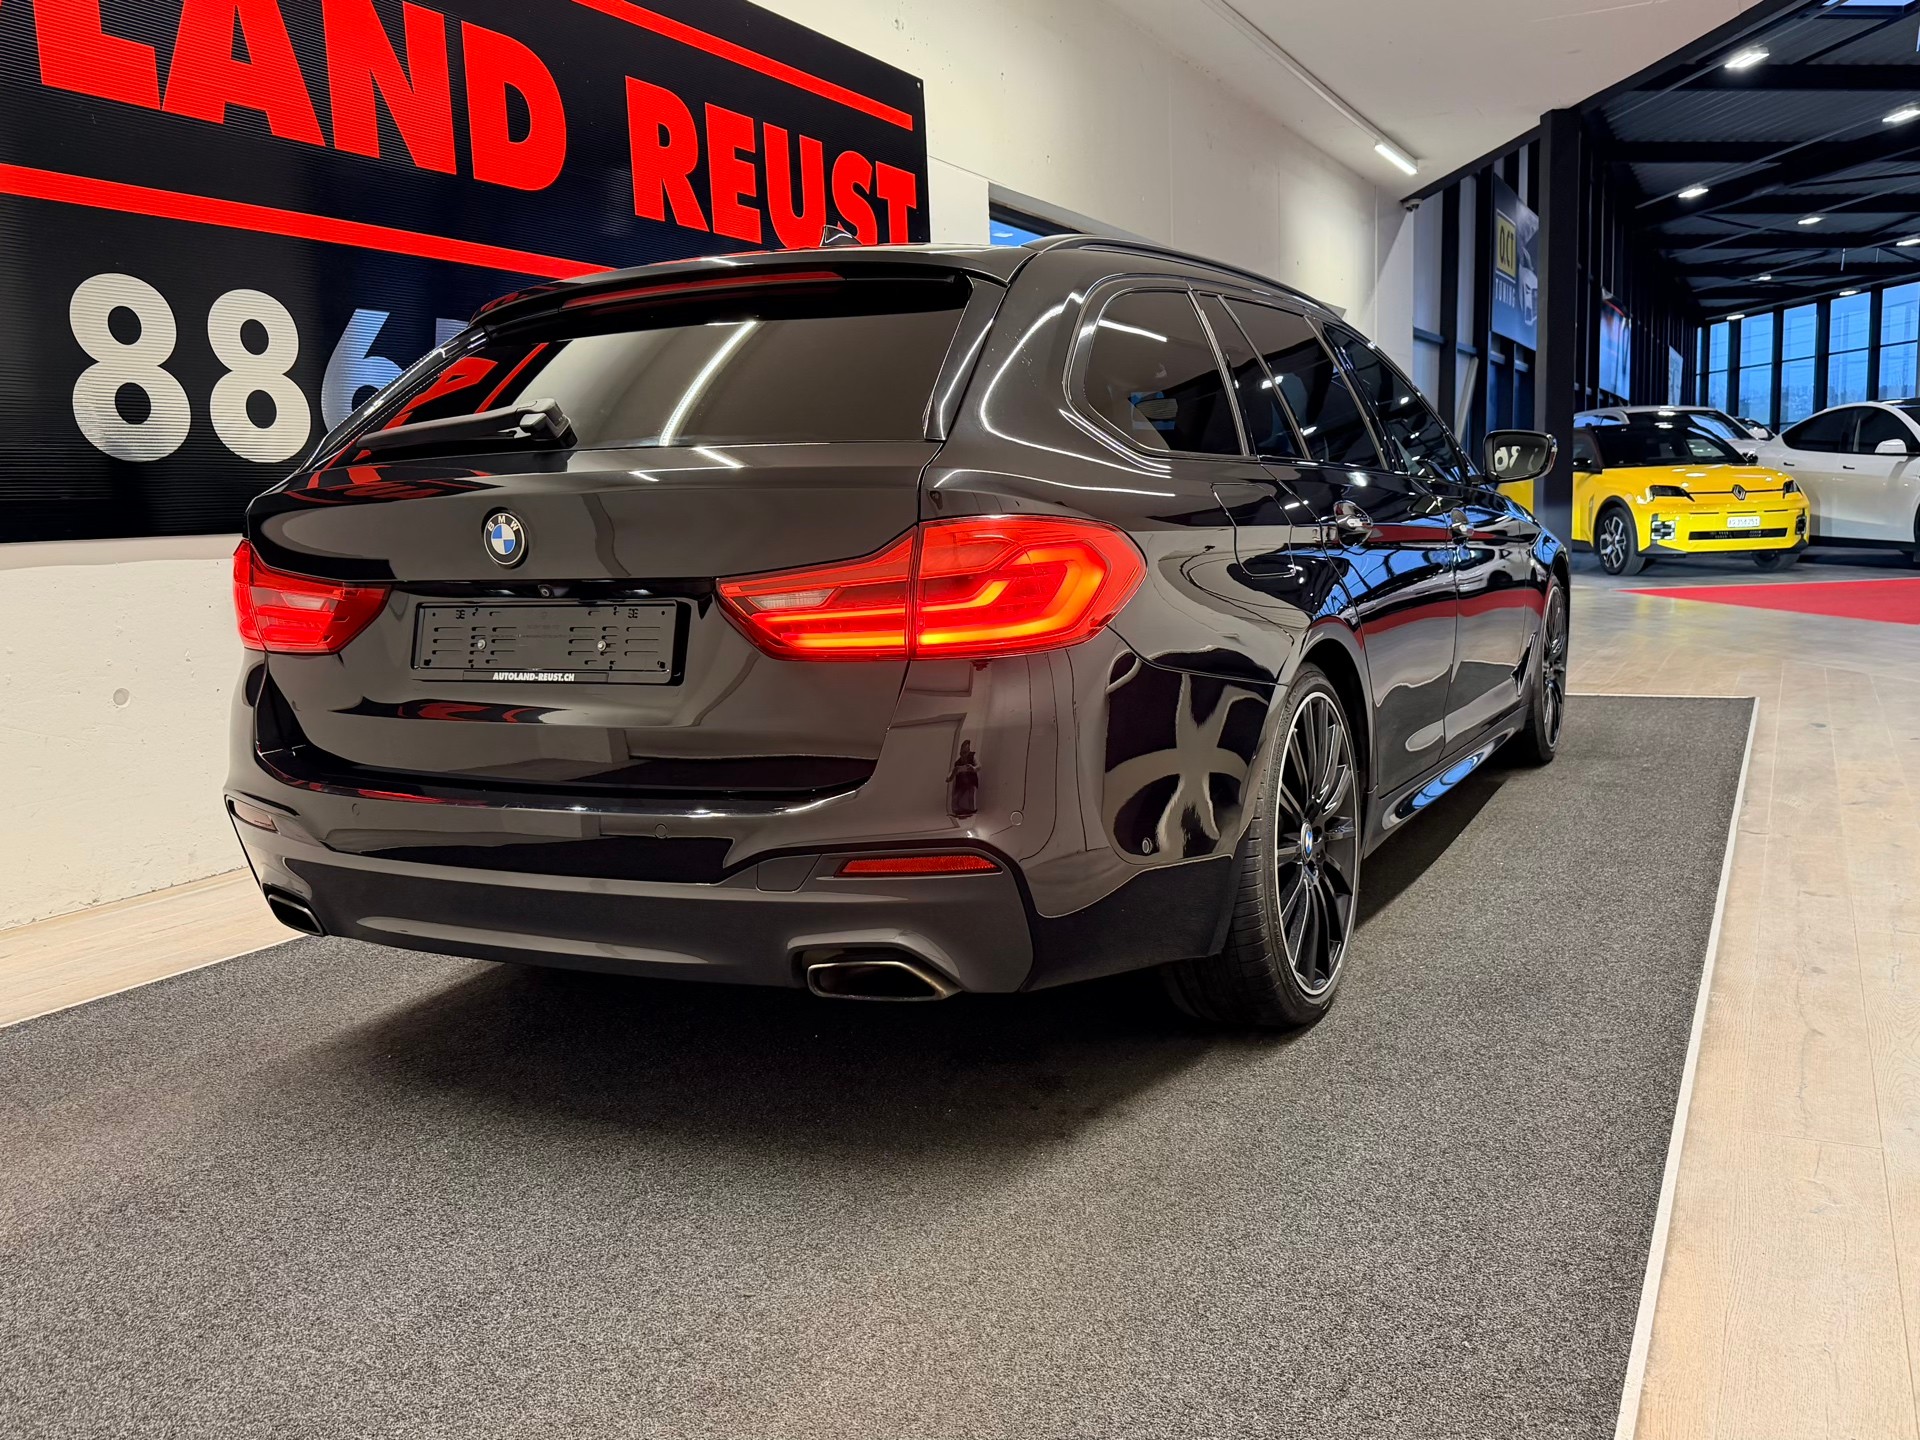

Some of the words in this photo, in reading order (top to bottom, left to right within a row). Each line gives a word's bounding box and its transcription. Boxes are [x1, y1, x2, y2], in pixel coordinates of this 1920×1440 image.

[625, 75, 917, 250] REUST
[69, 272, 469, 462] 886
[487, 515, 519, 532] BMW
[492, 672, 575, 681] AUTOLAND-REUST.CH
